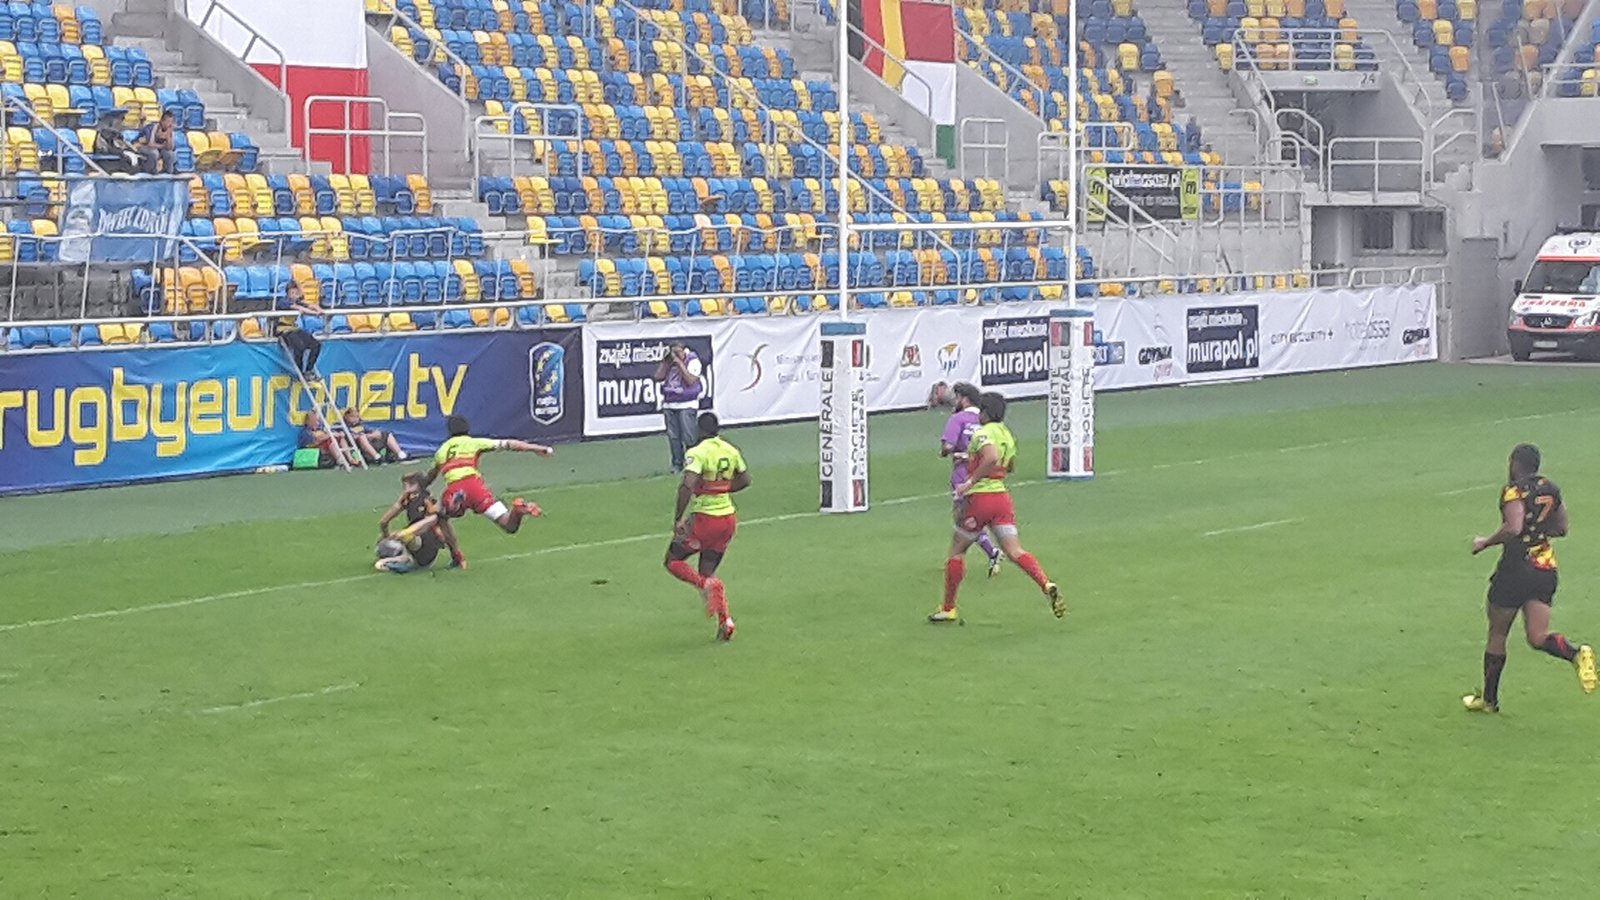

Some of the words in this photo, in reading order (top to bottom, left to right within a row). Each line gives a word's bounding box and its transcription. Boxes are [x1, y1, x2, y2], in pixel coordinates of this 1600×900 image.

[981, 342, 1049, 380] murapol
[1188, 330, 1258, 368] murapol.pl
[0, 353, 468, 466] rugbyeurope.tv
[1534, 495, 1554, 523] 7
